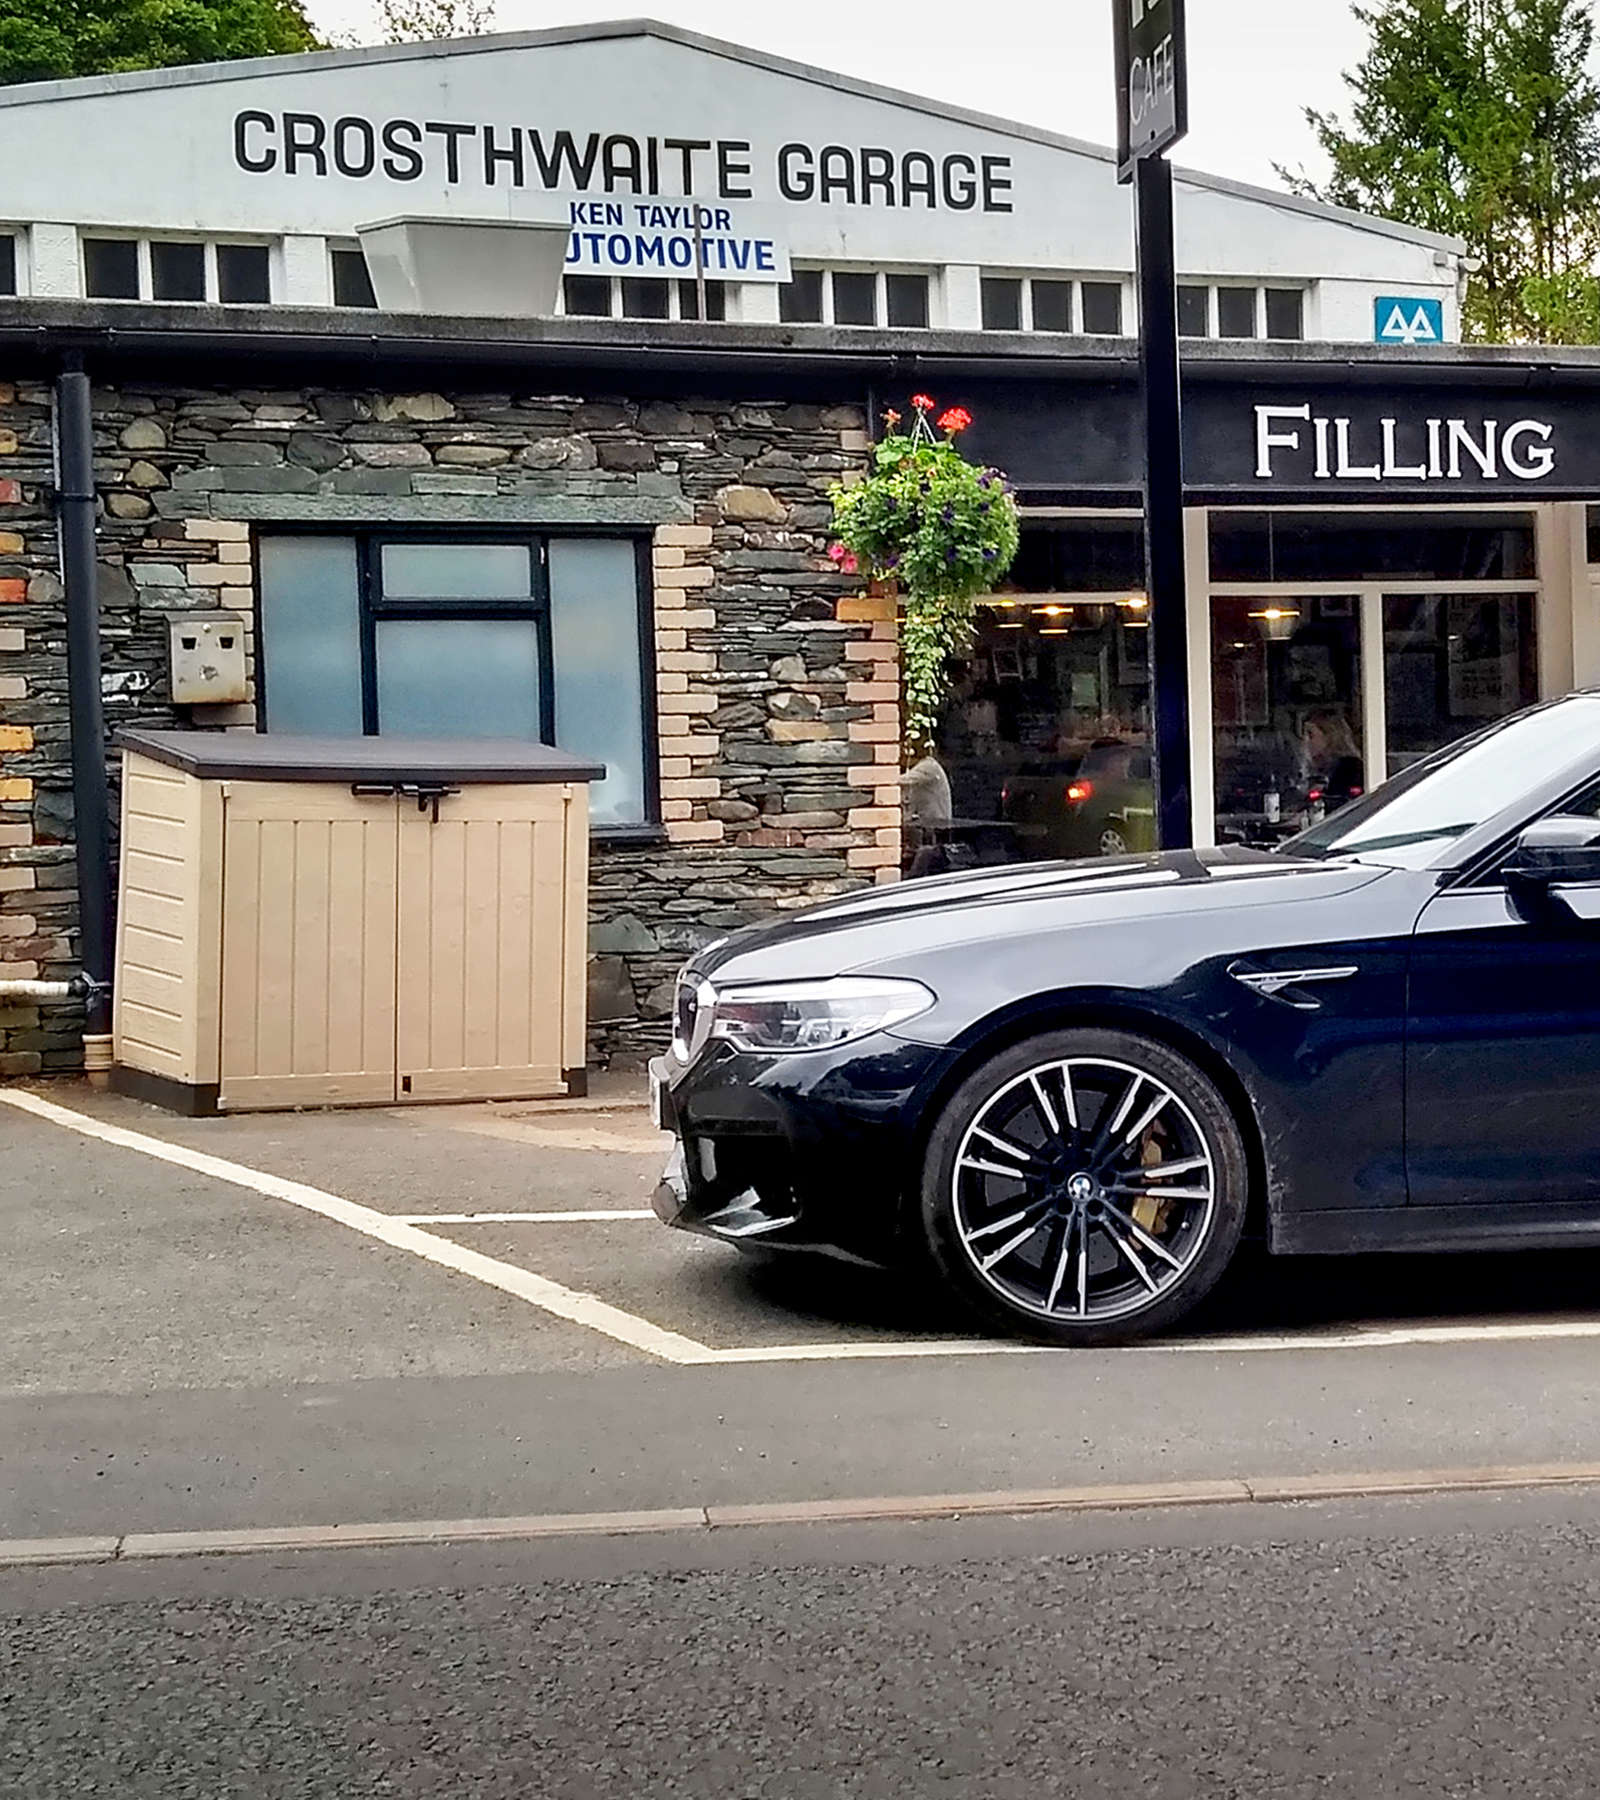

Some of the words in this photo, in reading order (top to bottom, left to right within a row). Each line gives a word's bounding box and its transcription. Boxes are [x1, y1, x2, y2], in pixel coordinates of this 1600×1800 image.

[1130, 33, 1174, 126] CAFE
[234, 109, 753, 198] CROSTHWAITE
[778, 142, 1013, 213] GARAGE
[565, 232, 776, 271] UTOMOTIVE
[570, 202, 623, 226] KEN
[634, 204, 731, 231] TAYLOR
[1254, 403, 1555, 480] FILLING
